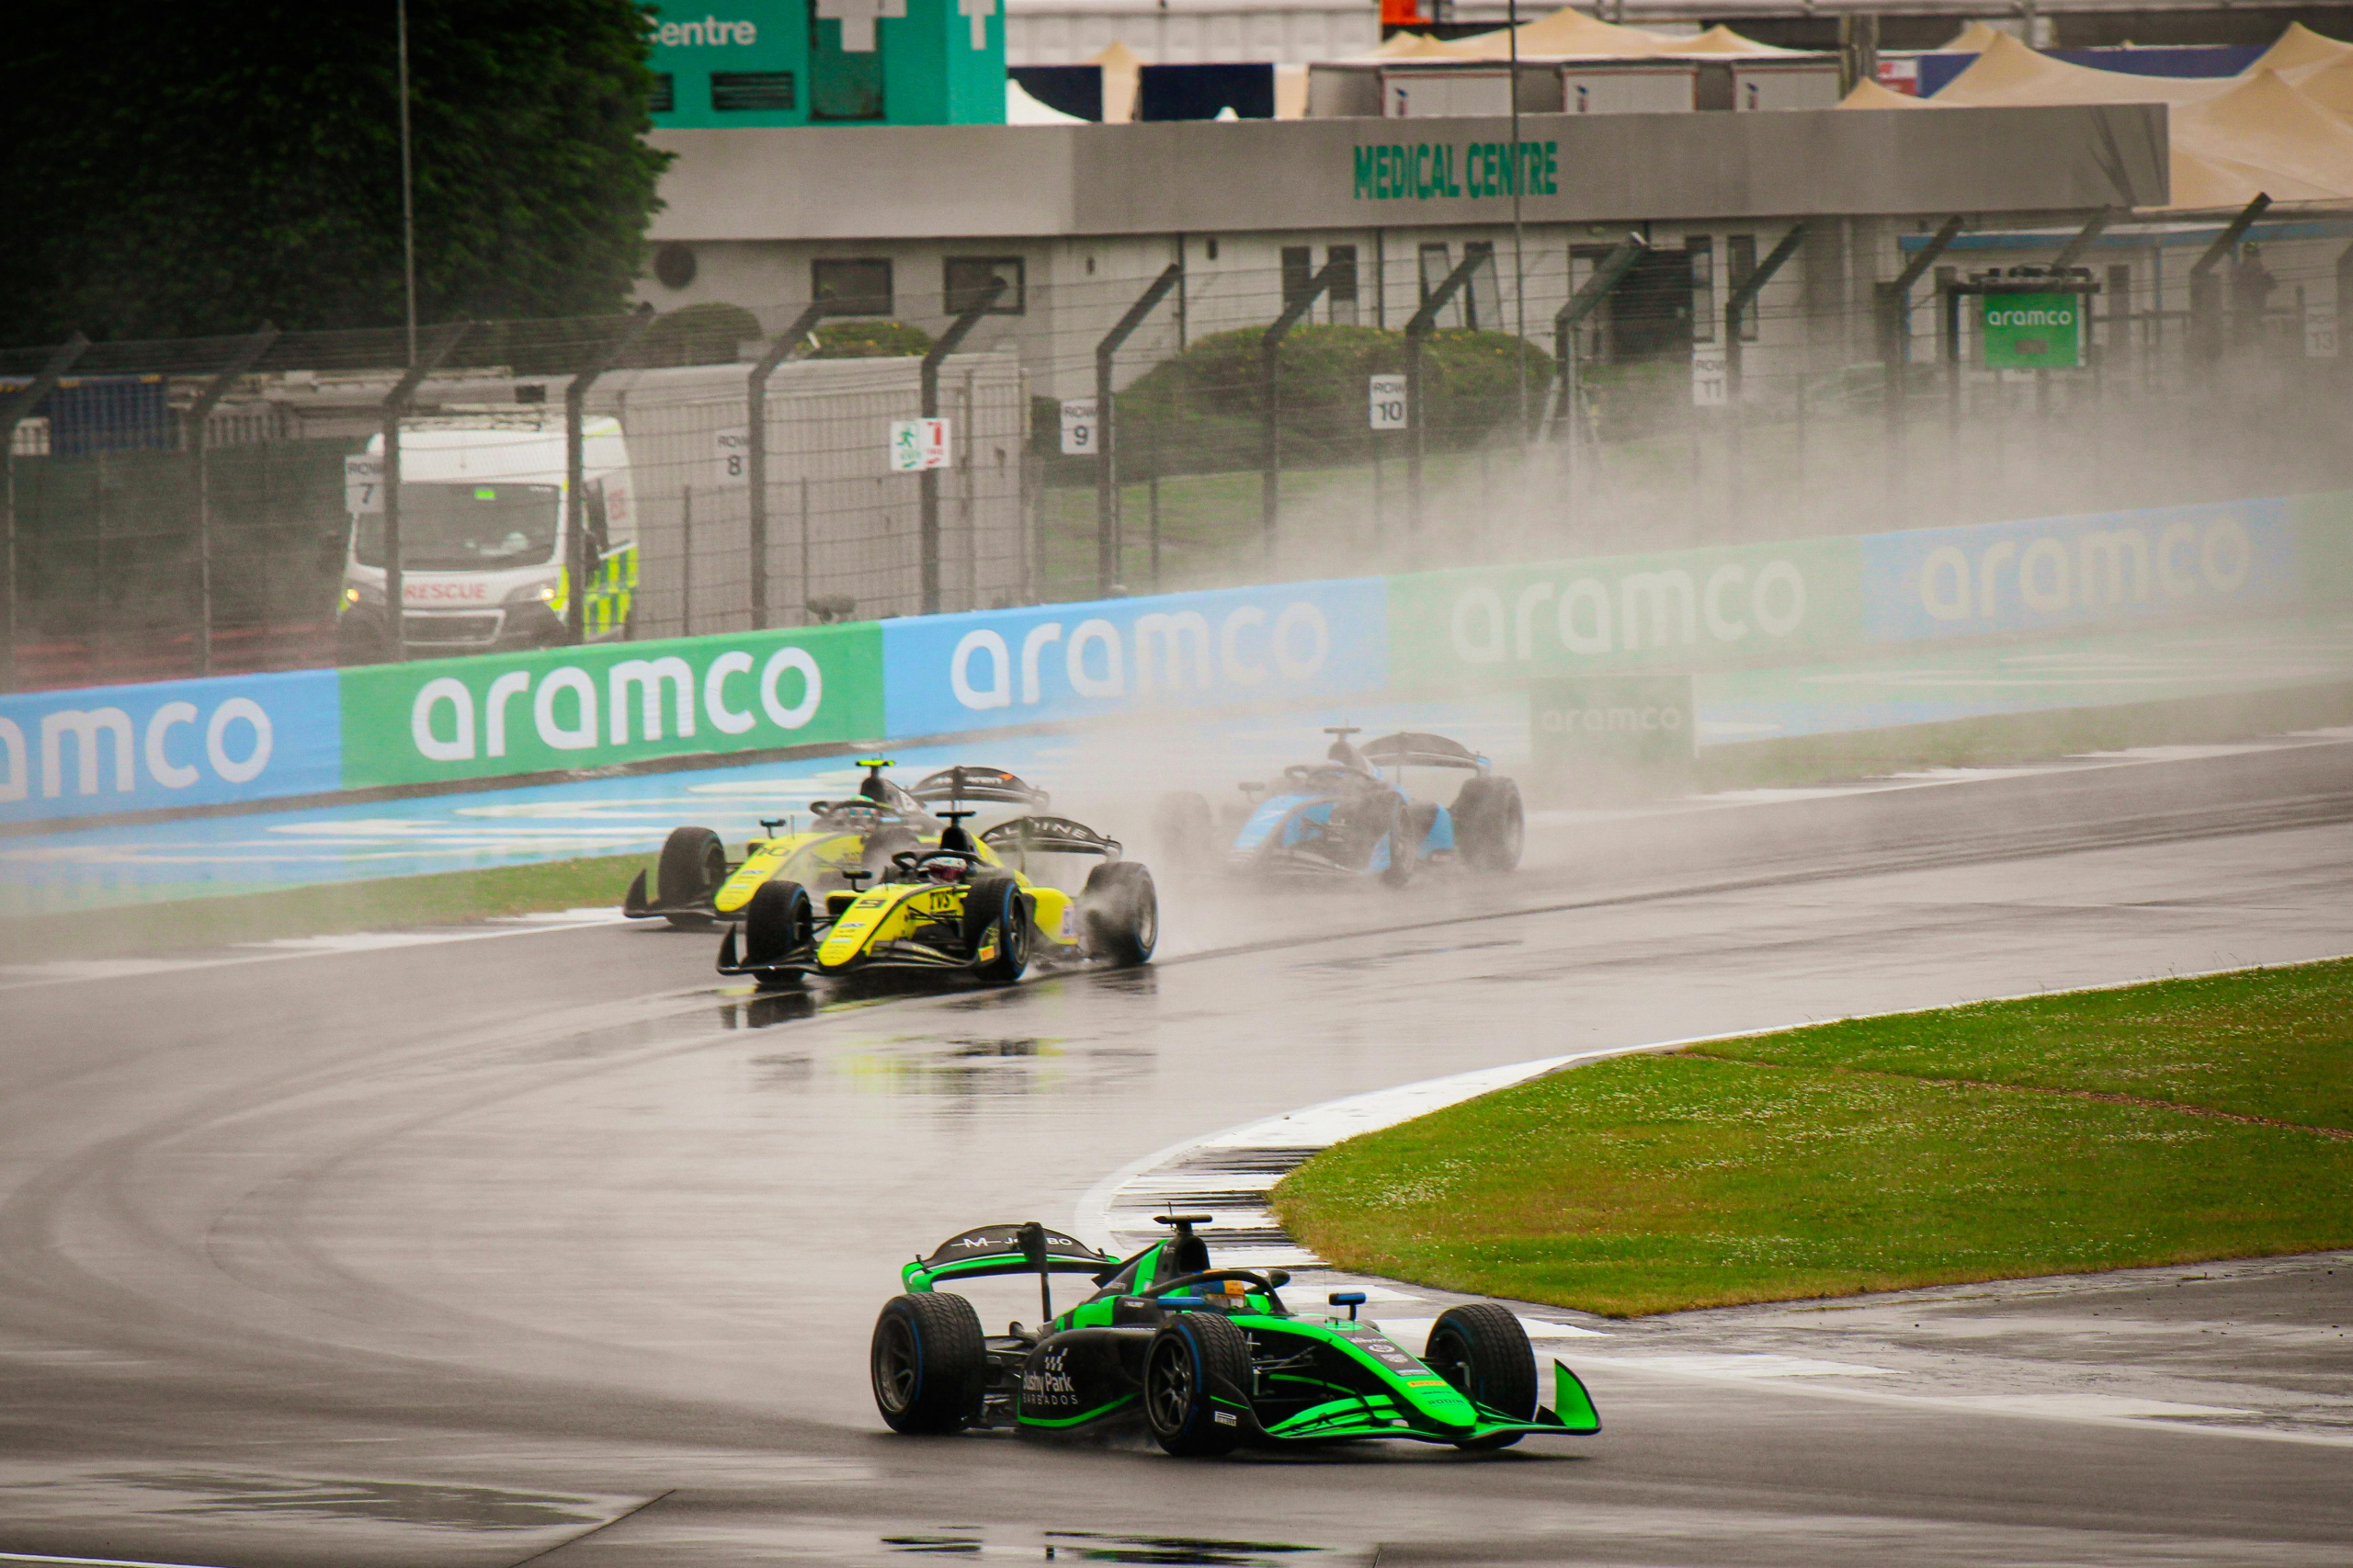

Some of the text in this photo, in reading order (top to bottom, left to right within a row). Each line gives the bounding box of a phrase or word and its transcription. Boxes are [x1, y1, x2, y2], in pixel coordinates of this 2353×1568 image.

[1354, 142, 1557, 199] MEDICAL CENTRE
[1988, 310, 2073, 325] aramco
[1374, 381, 1406, 394] ROW
[1702, 378, 1722, 398] 11
[1064, 405, 1097, 418] ROW
[1380, 401, 1403, 421] 10
[717, 435, 749, 449] ROW
[1074, 425, 1088, 446] 9
[727, 454, 742, 476] 8
[358, 482, 375, 505] 7
[1921, 517, 2251, 621] aramco
[404, 583, 488, 599] RESCUE
[1450, 559, 1806, 664] aramco
[950, 600, 1329, 711] aramco
[411, 646, 823, 762] aramco
[1540, 707, 1681, 733] aramco
[1045, 1372, 1074, 1392] Park
